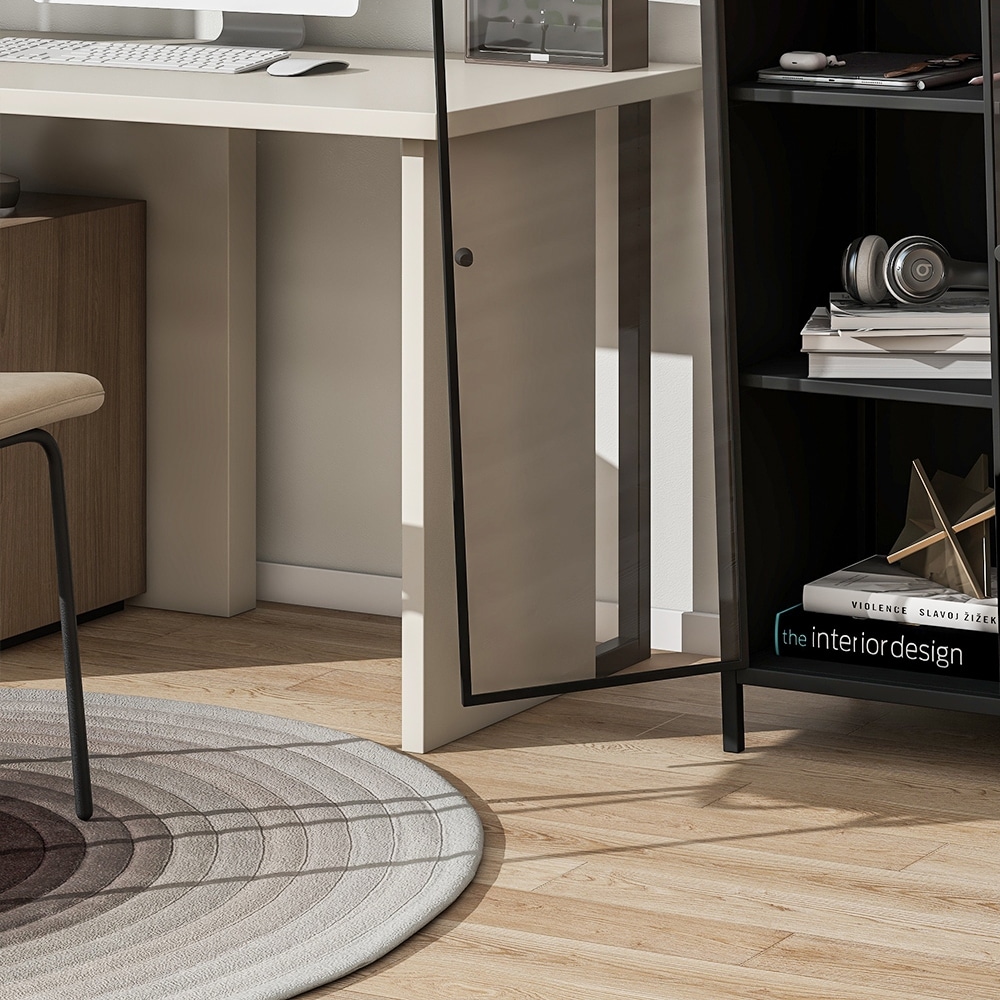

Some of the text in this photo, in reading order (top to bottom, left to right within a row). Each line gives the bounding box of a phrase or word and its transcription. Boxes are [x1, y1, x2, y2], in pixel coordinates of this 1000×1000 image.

[851, 601, 997, 625] VIOLENCE SLAVOJ ŽIŽEK
[782, 629, 807, 647] the
